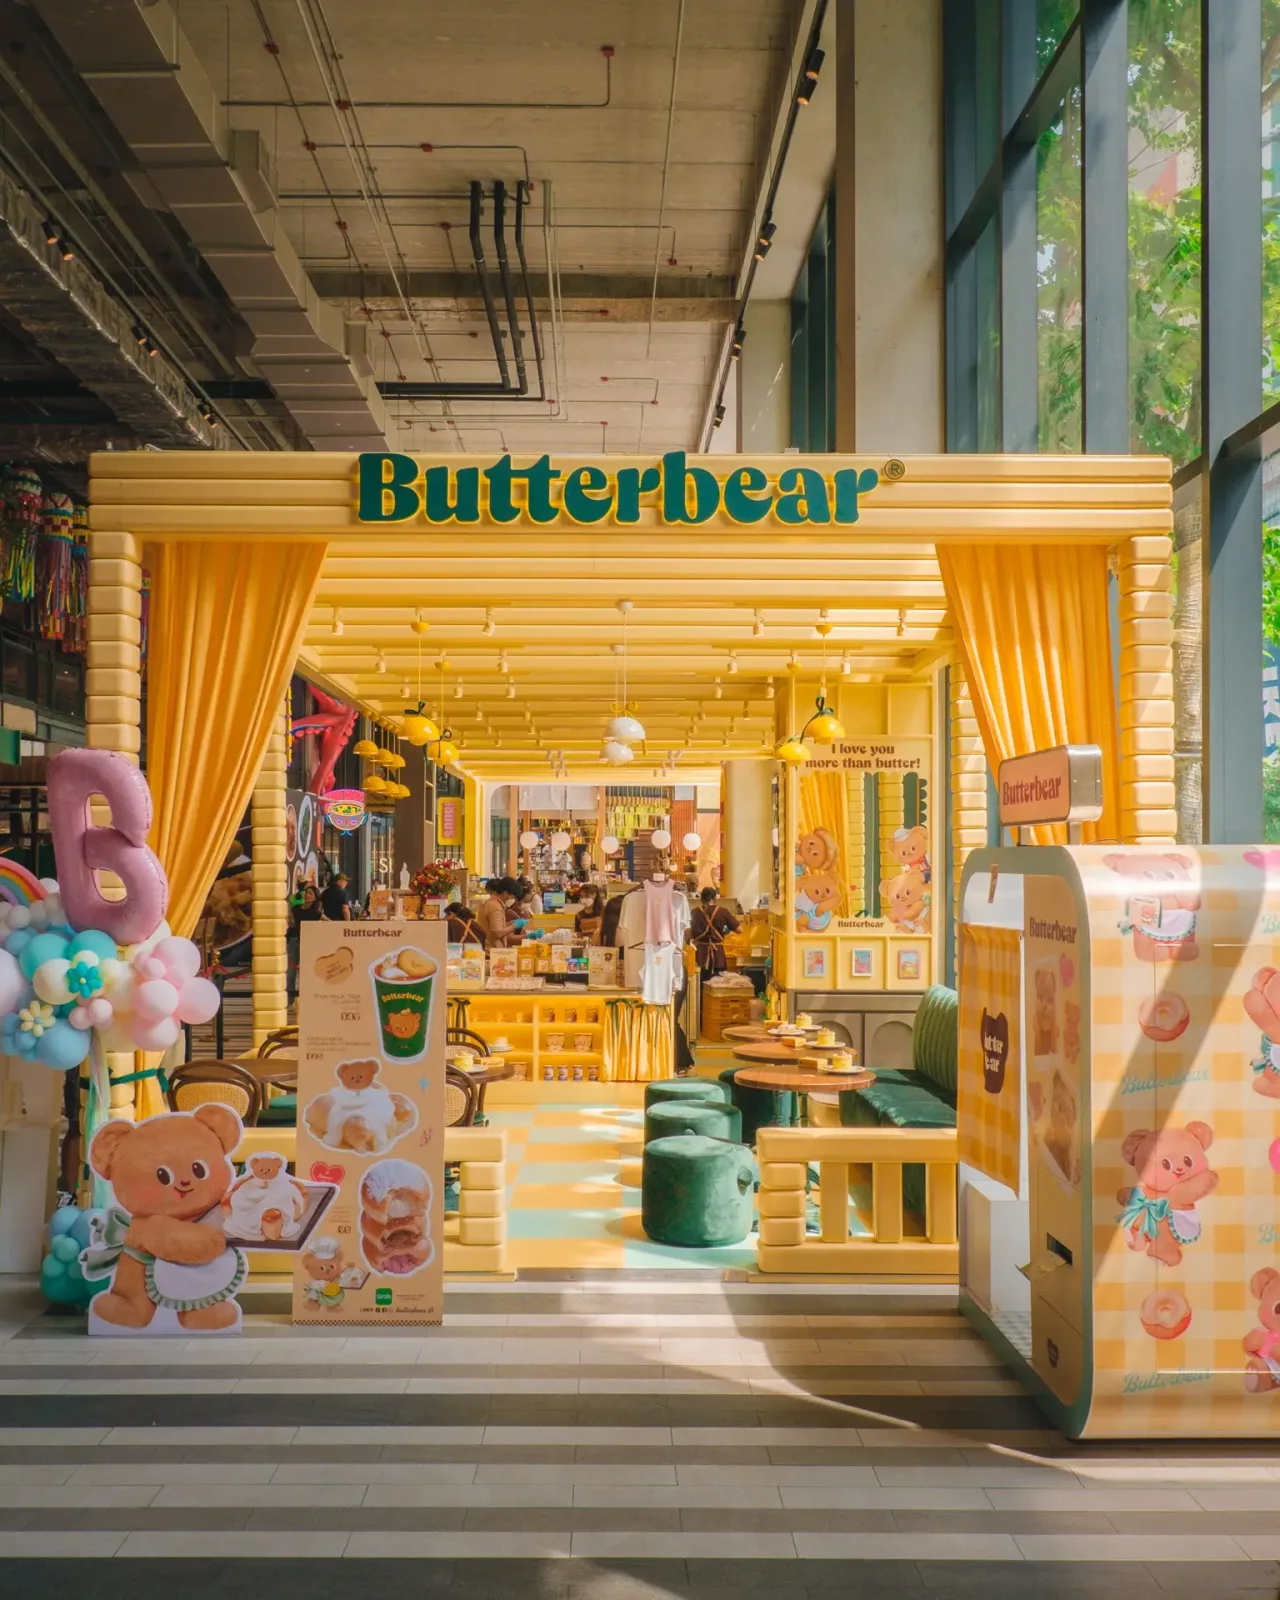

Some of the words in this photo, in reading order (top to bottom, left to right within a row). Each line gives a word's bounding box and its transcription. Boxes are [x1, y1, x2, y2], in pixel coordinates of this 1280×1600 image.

[358, 451, 879, 524] Butterbear
[831, 743, 837, 754] I
[839, 743, 867, 754] love
[870, 745, 895, 756] you
[805, 759, 839, 768] more
[842, 758, 872, 768] than
[875, 758, 921, 769] butter!
[1002, 776, 1062, 806] Butterbear
[837, 920, 885, 928] Butterbear
[1029, 917, 1077, 944] Butterbear
[343, 928, 403, 938] Butterbear
